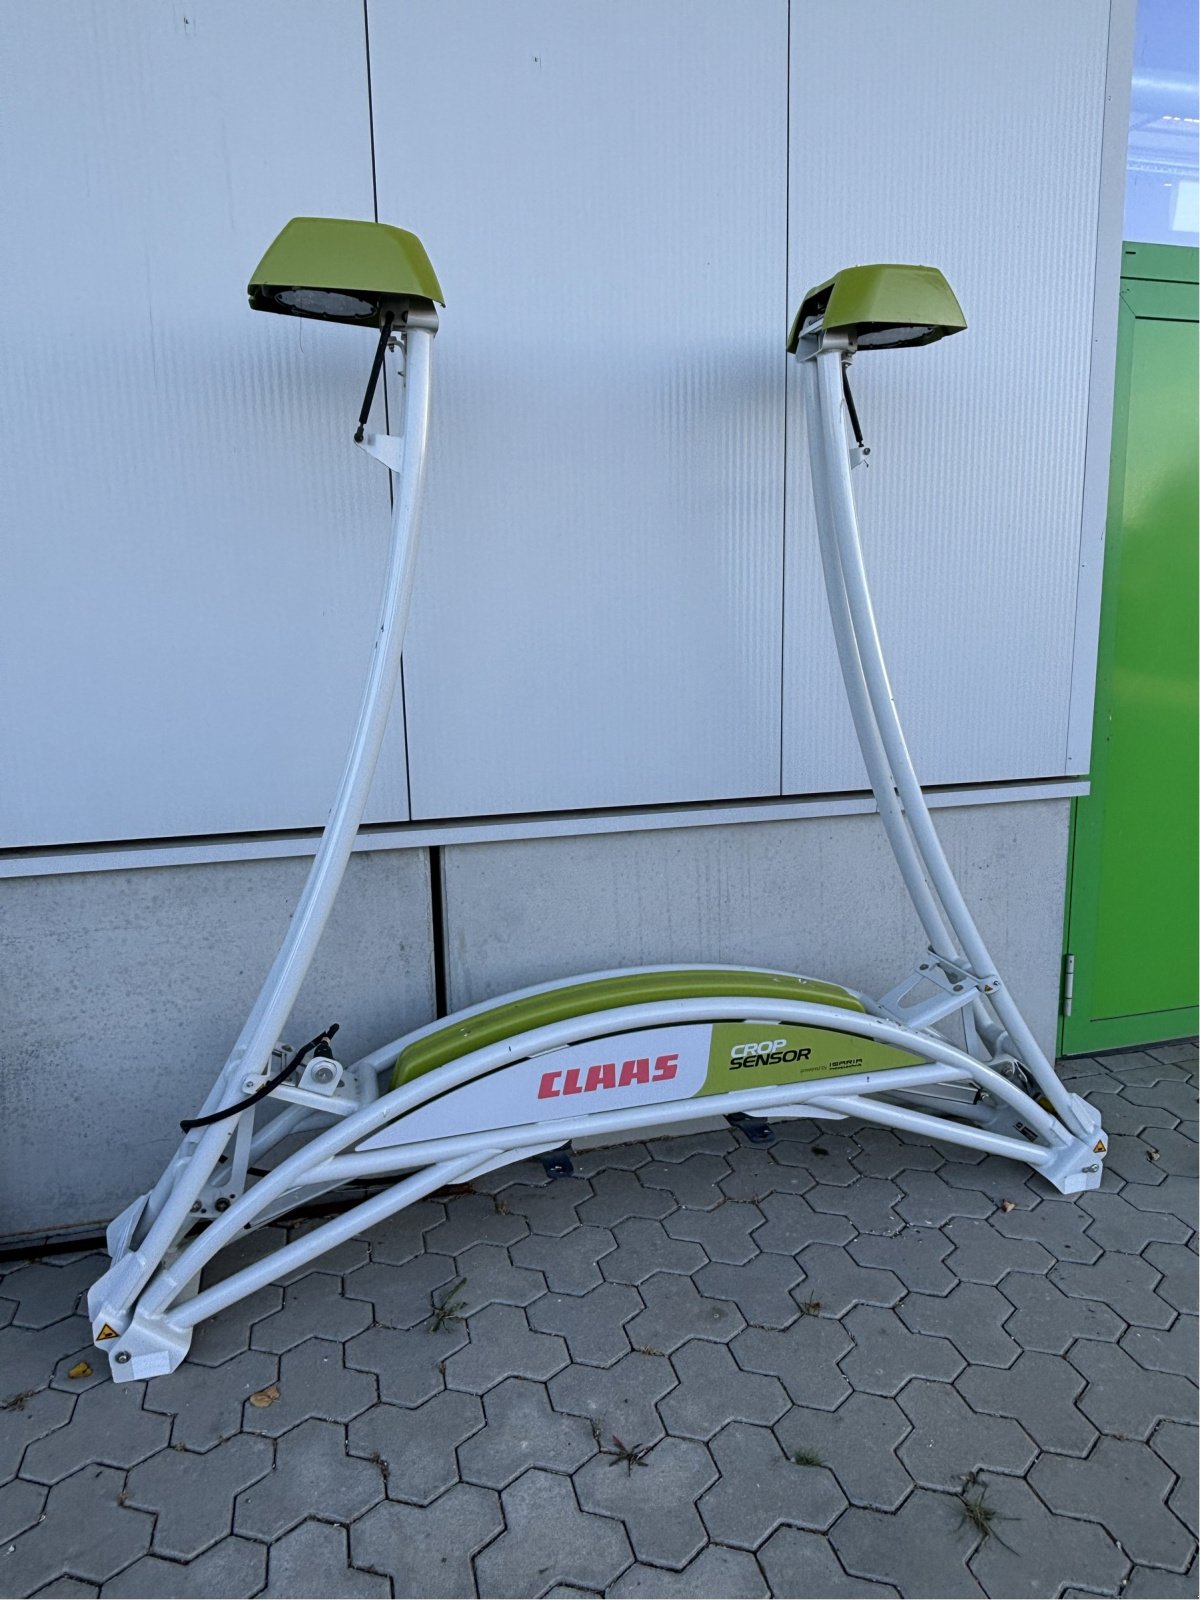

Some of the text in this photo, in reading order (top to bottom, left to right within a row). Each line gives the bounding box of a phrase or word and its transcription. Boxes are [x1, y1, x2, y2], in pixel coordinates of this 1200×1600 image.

[729, 1048, 811, 1070] SENSOR
[731, 1039, 787, 1058] CROP
[538, 1054, 678, 1099] CLAAS
